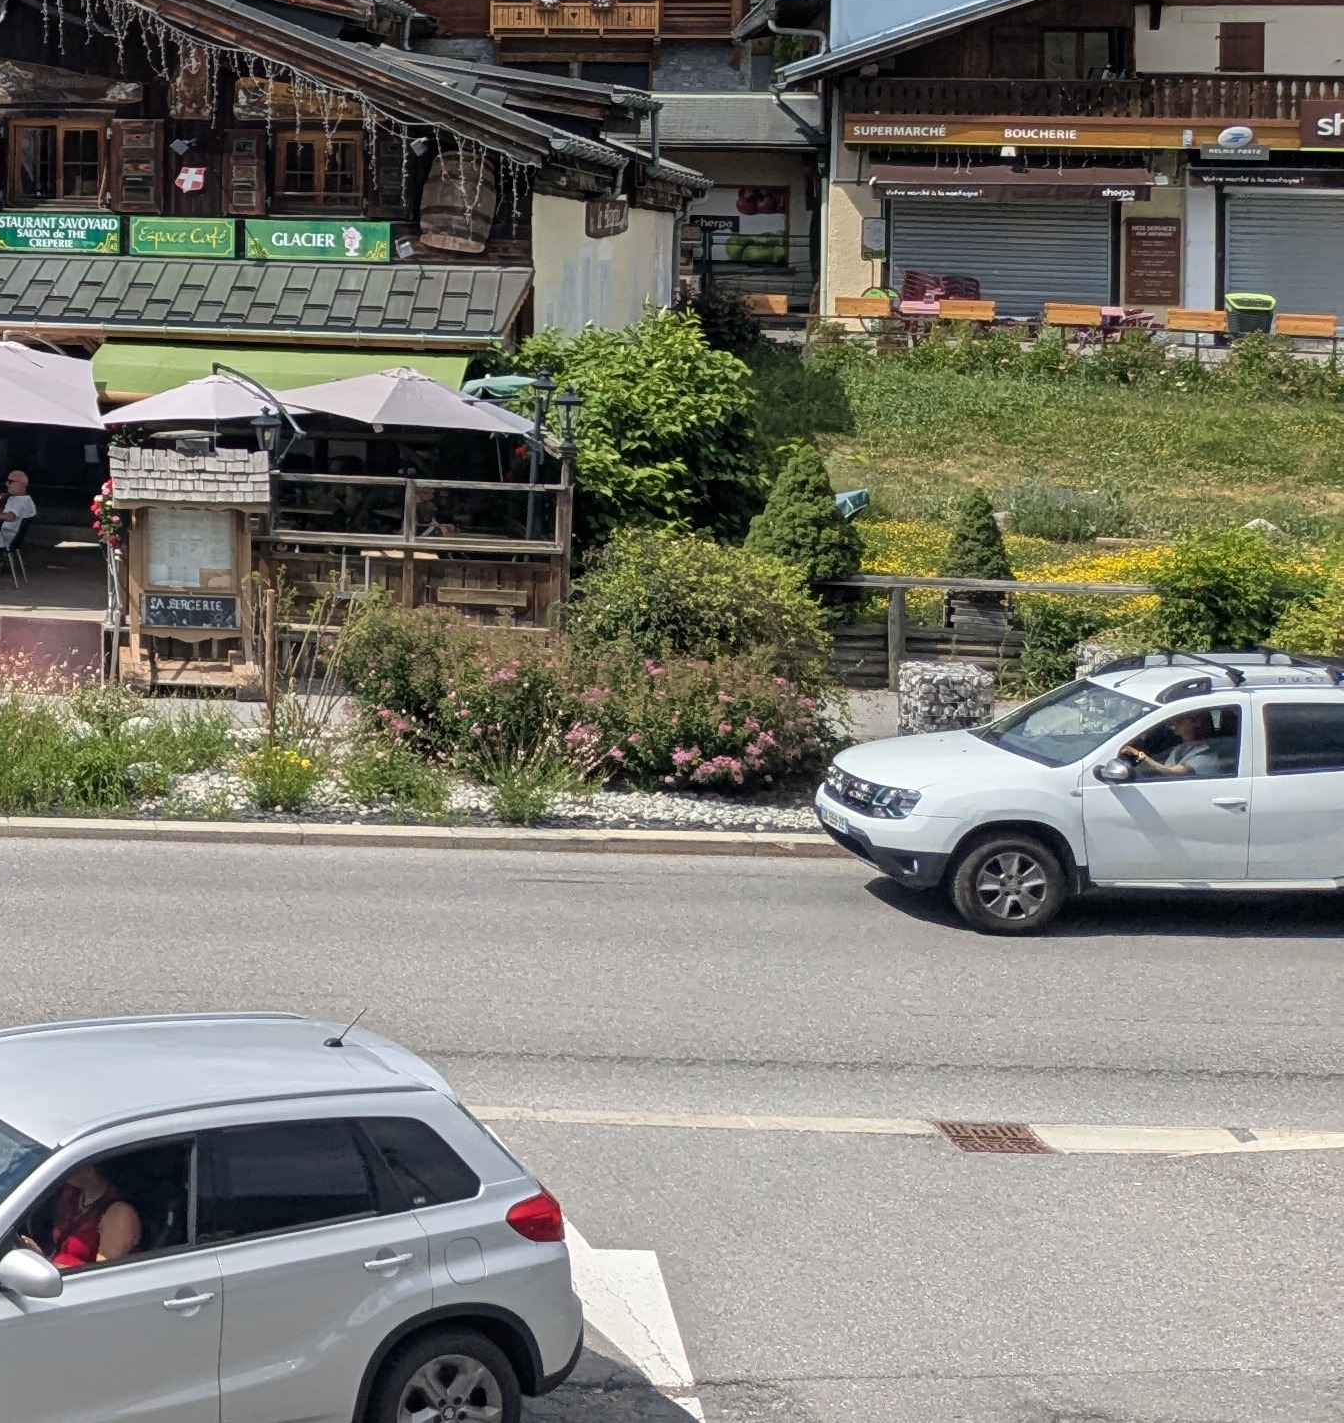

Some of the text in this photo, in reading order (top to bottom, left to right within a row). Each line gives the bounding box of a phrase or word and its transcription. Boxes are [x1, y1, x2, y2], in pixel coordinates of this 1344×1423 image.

[853, 124, 946, 137] SUPERMARCHÉ
[1004, 129, 1077, 139] BOUCHERIE
[1102, 188, 1136, 197] sherpa
[58, 217, 118, 231] SAVOYARD
[16, 228, 87, 239] SALON de THE
[138, 226, 227, 250] Espace Café
[271, 232, 335, 247] GLACIER
[28, 238, 74, 248] CREPERIE
